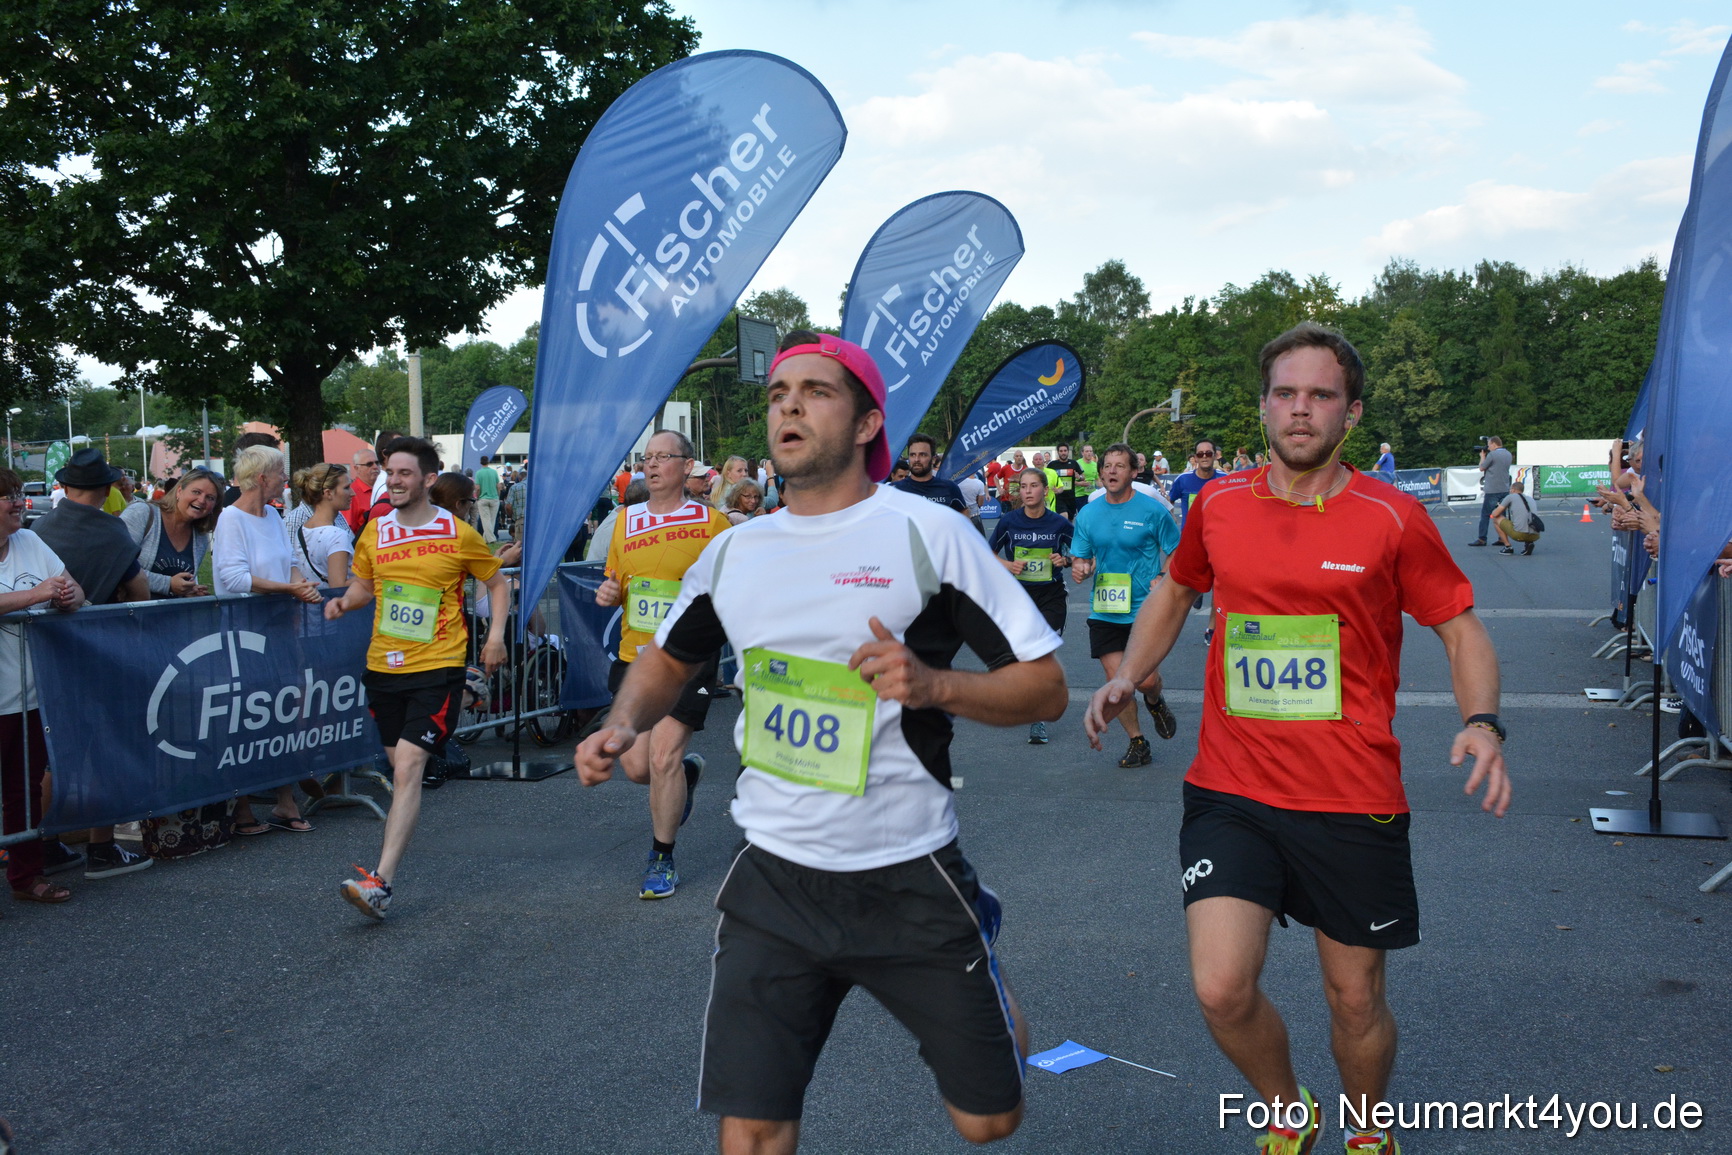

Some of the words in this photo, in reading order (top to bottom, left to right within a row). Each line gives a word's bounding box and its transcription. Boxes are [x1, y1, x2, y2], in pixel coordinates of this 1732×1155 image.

[614, 102, 778, 322] Fischer
[669, 143, 797, 318] AUTOMOBILE
[884, 223, 983, 369] Fischer
[920, 250, 995, 367] AUTOMOBILE
[478, 396, 514, 443] Fischer
[960, 388, 1048, 451] Frischmann
[1017, 408, 1038, 425] Druck
[1052, 381, 1077, 403] Medien
[490, 405, 518, 442] AUTOMOBILE
[1398, 481, 1431, 492] Frischmann
[1545, 471, 1571, 484] AOK
[1578, 470, 1611, 480] GESUND
[376, 548, 412, 565] MAX
[417, 542, 459, 557] BÖGL
[624, 534, 660, 553] MAX
[666, 527, 710, 542] BÖGL
[1321, 560, 1366, 573] Alexander
[638, 599, 674, 619] 917
[1096, 588, 1126, 602] 1064
[390, 604, 424, 626] 869
[1235, 656, 1327, 690] 1048
[1249, 696, 1280, 705] Alexander
[217, 717, 364, 770] AUTOMOBILE
[764, 703, 840, 753] 408
